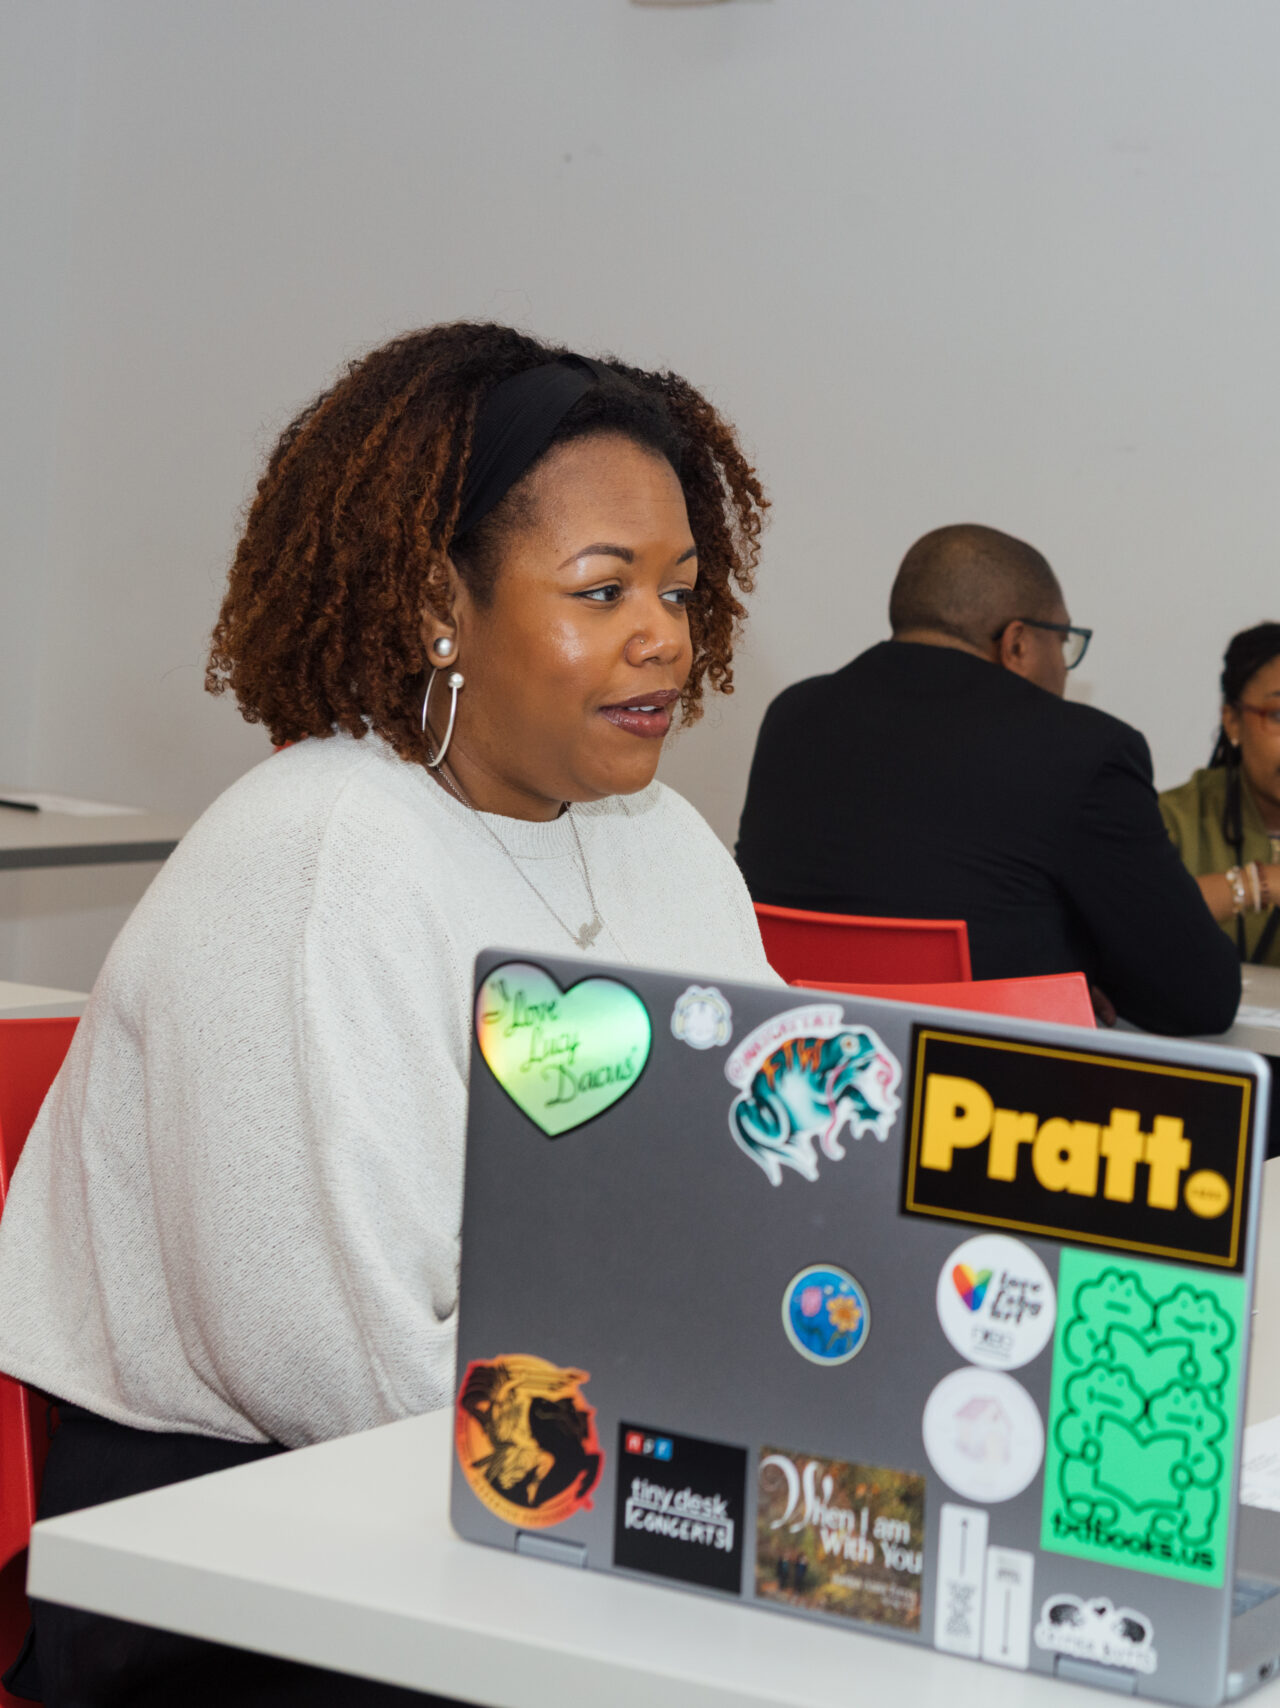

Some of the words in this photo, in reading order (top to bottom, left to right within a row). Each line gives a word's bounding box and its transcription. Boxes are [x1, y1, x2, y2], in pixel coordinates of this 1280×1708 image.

[520, 1027, 581, 1073] Lucy
[632, 1477, 675, 1513] tiny
[674, 1486, 728, 1519] desk
[759, 1454, 855, 1534] When
[860, 1506, 869, 1537] I
[873, 1515, 911, 1545] am
[819, 1527, 875, 1565] With
[880, 1540, 923, 1575] You
